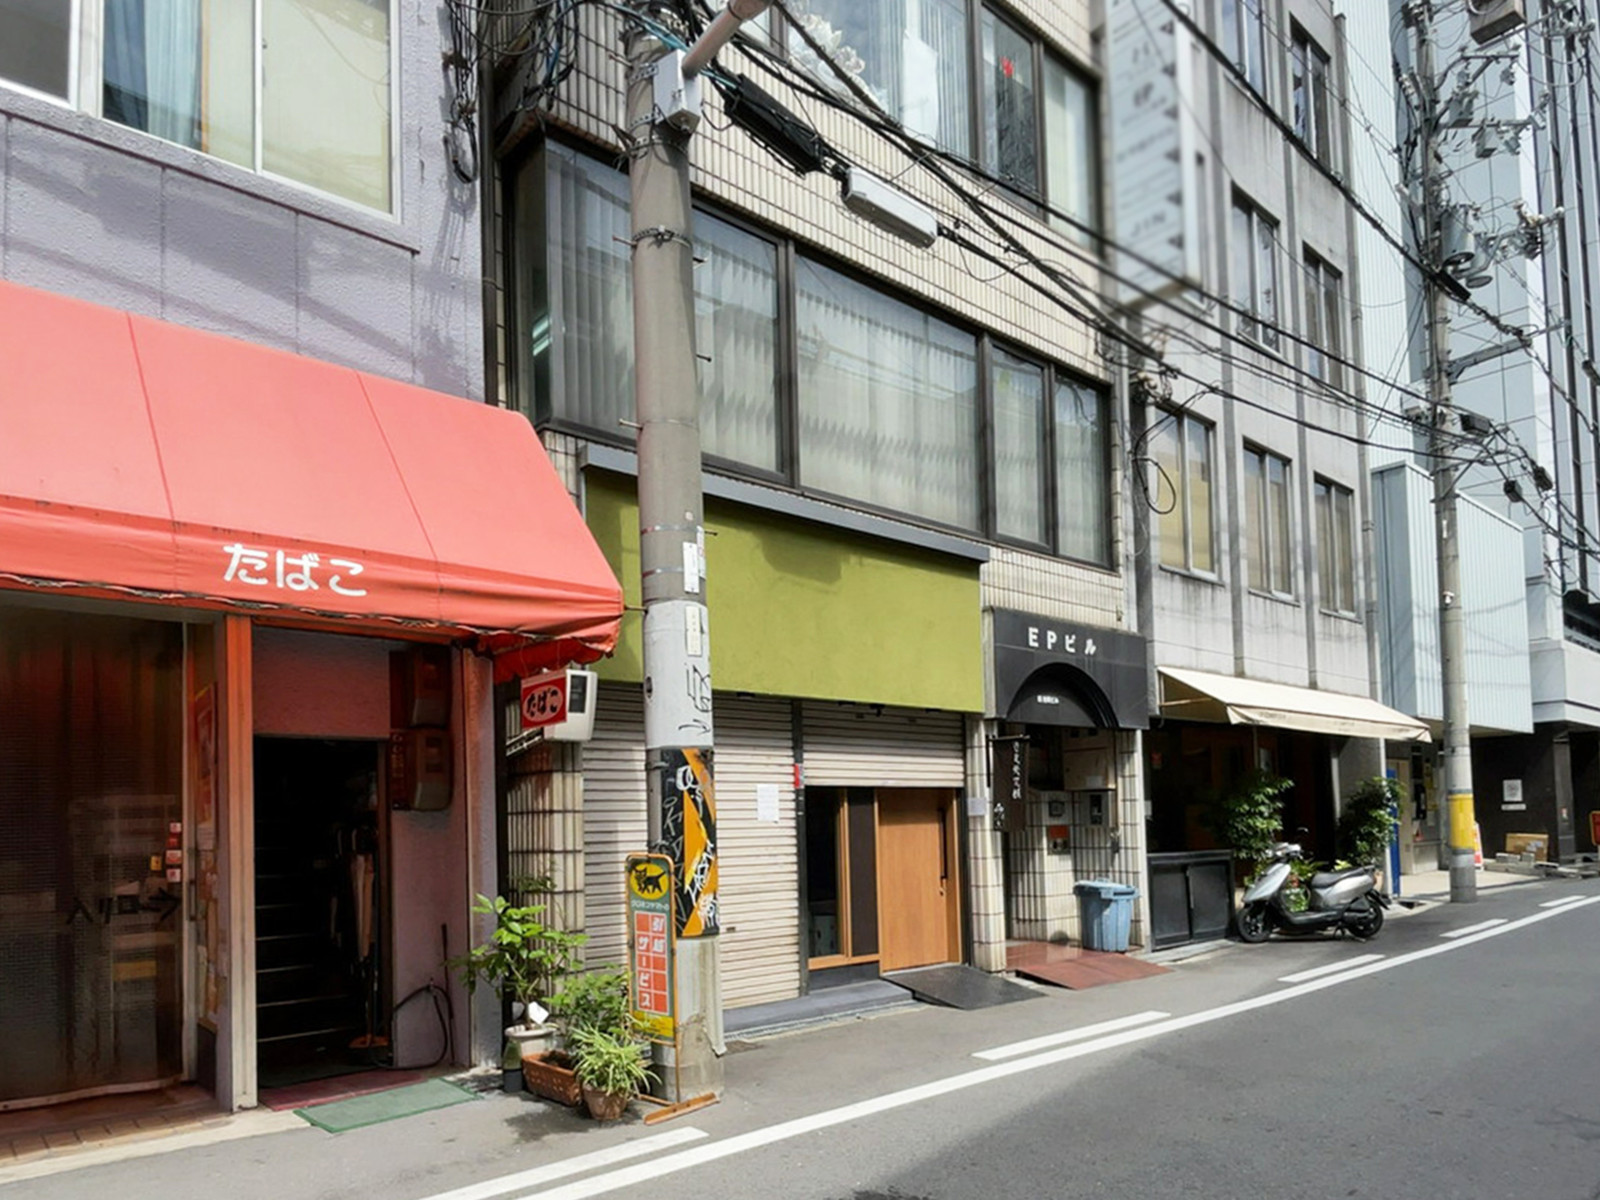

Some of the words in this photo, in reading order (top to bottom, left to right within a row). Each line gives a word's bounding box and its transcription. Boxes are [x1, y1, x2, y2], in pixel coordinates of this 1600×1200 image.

[223, 543, 367, 596] たばこ
[1027, 627, 1096, 655] EPビル
[527, 687, 558, 718] たばこ
[638, 938, 650, 1007] サービス
